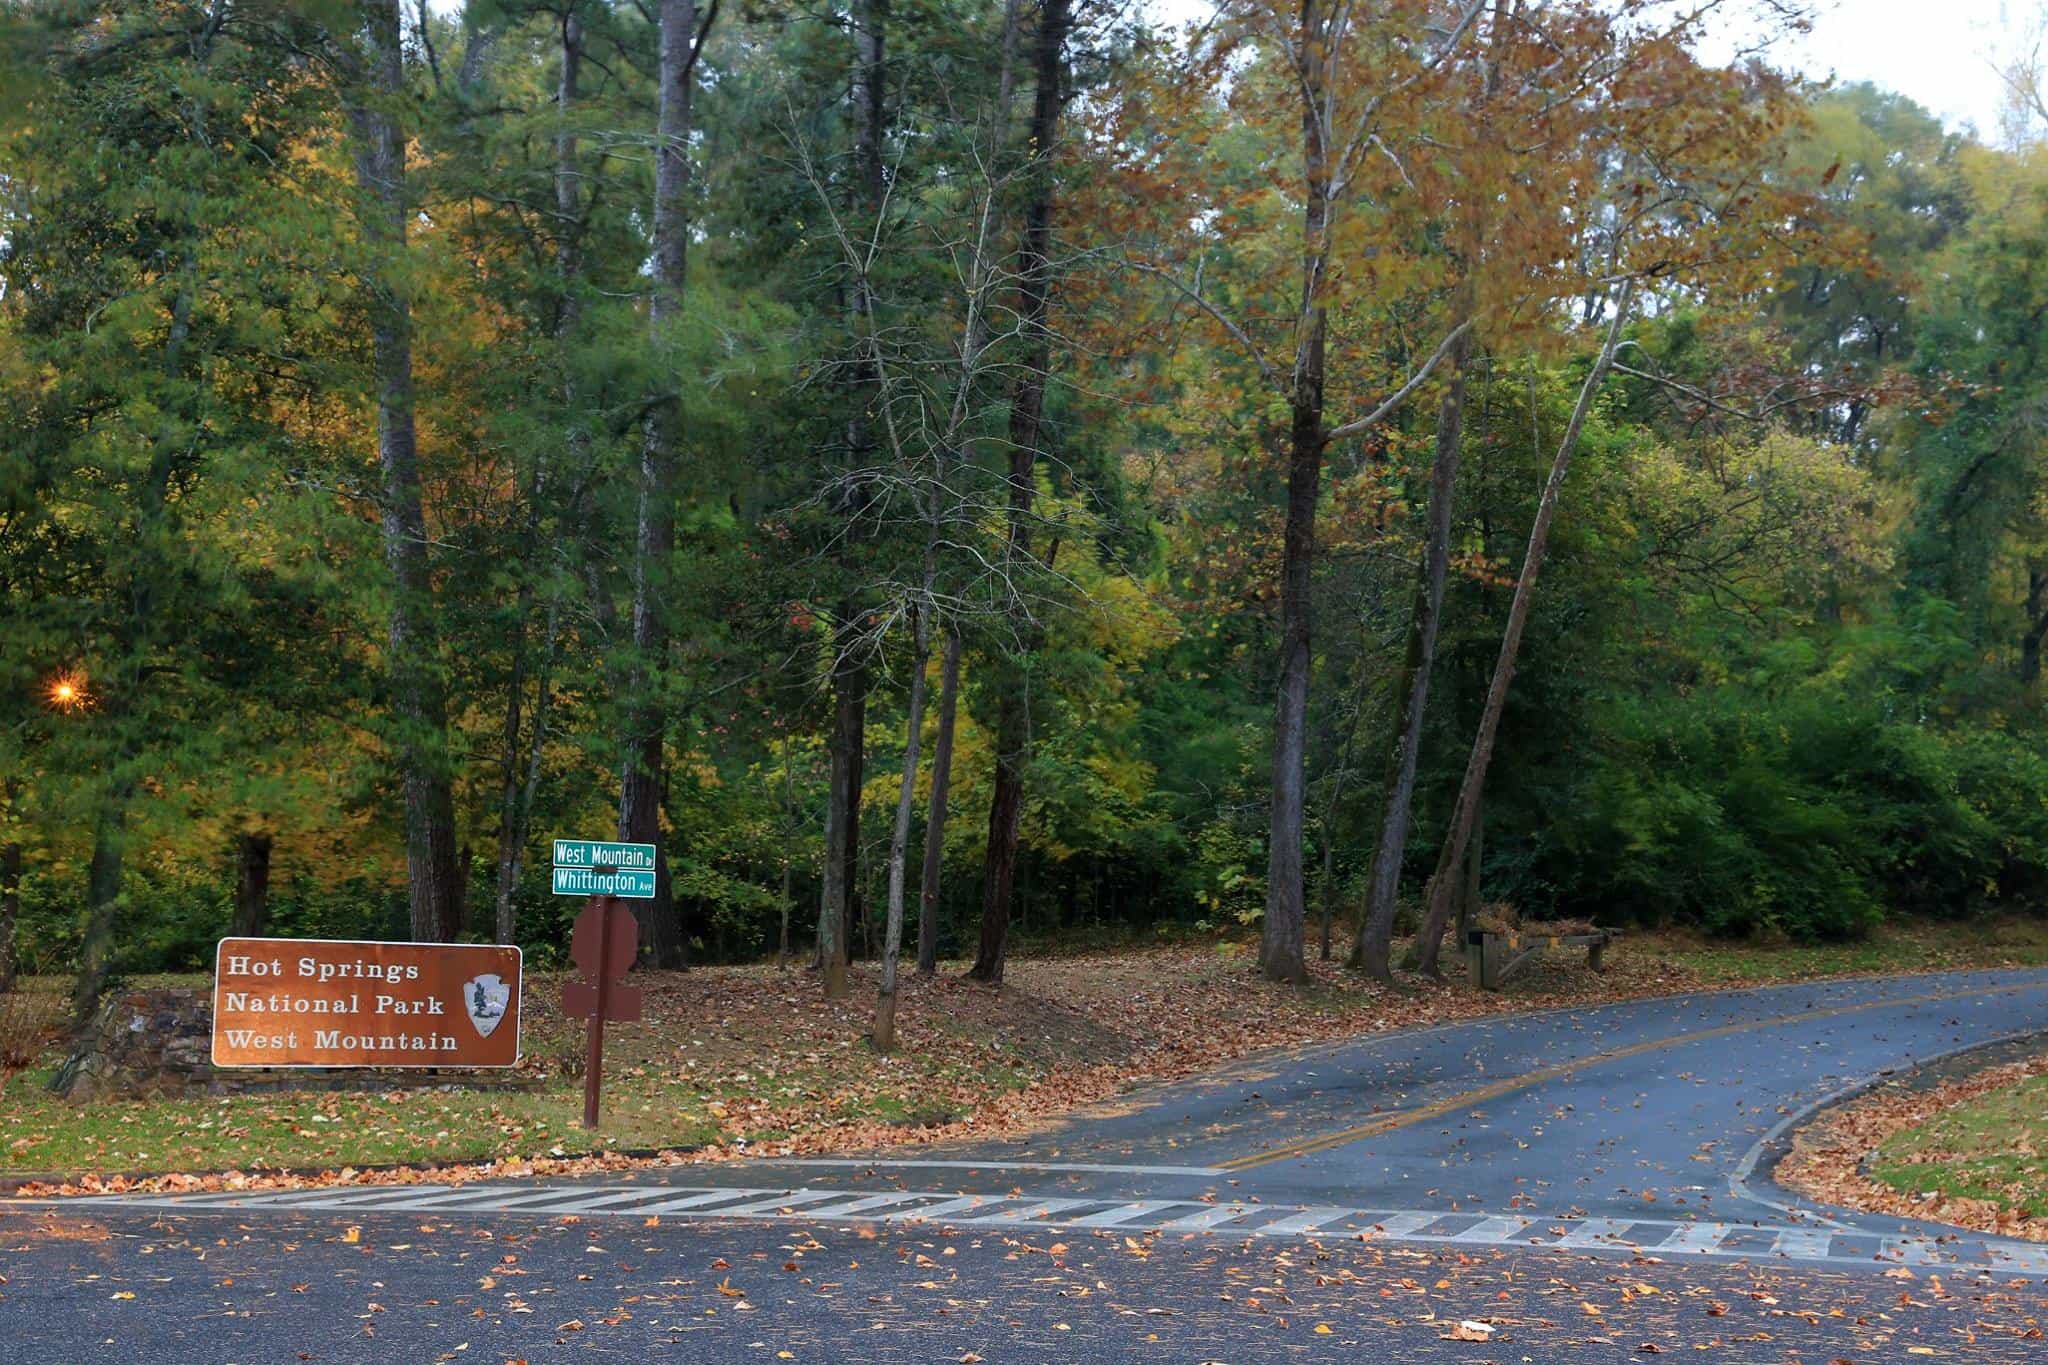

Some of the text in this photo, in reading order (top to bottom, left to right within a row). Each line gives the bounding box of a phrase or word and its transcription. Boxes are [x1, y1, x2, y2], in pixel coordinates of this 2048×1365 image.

[557, 843, 585, 863] West
[592, 845, 643, 866] Mountain
[557, 870, 652, 894] Whittington Ave
[227, 956, 419, 983] Hot Springs
[224, 992, 445, 1015] National Park
[224, 1029, 458, 1050] West Mountain
